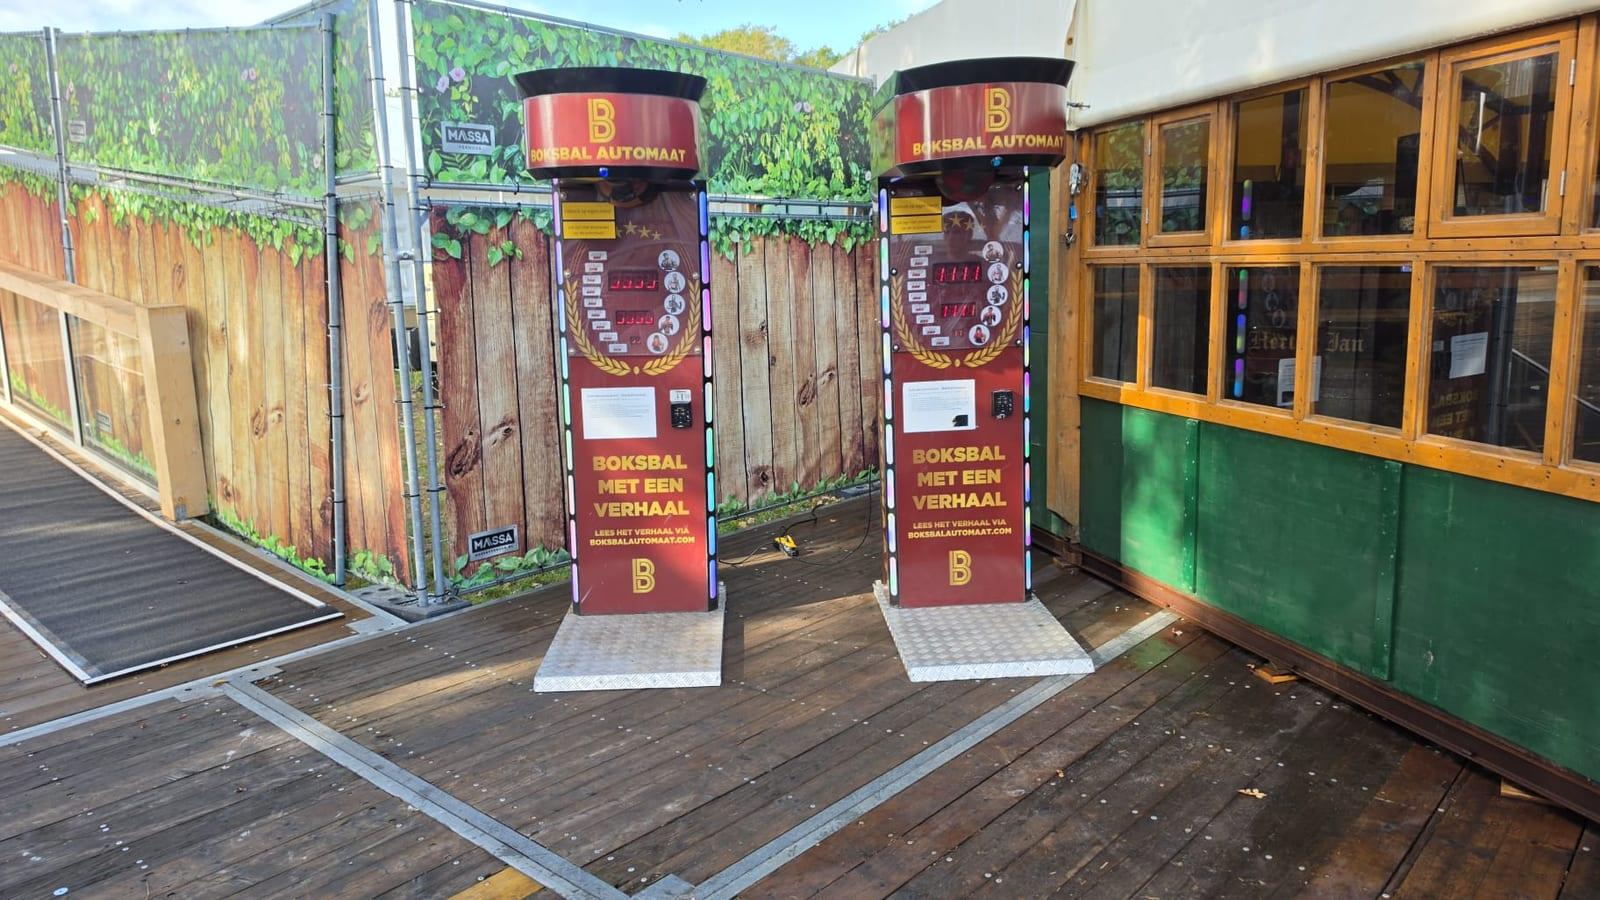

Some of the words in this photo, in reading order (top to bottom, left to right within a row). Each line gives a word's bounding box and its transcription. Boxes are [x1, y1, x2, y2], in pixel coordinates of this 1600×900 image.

[984, 88, 1011, 132] B
[588, 98, 616, 143] B
[448, 128, 490, 144] MASSA
[912, 136, 987, 156] BOKSBAL
[991, 134, 1064, 149] AUTOMAAT
[531, 146, 592, 162] BOKSBAL
[596, 146, 686, 162] AUTOMAAT
[1249, 329, 1297, 350] Hert
[592, 454, 688, 471] BOKSBAL
[912, 446, 1006, 464] BOKSBAL
[598, 478, 640, 494] MET
[644, 478, 684, 494] EEN
[917, 470, 958, 487] MET
[962, 469, 1001, 485] EEN
[593, 501, 690, 518] VERHAAL
[912, 492, 1007, 510] VERHAAL
[594, 529, 615, 537] LEES
[618, 528, 633, 536] HET
[634, 528, 674, 536] VERHAAL
[675, 527, 690, 535] VIA
[913, 522, 933, 530] LEES
[934, 520, 952, 528] HET
[952, 520, 990, 528] VERHAAL
[992, 518, 1007, 526] VIA
[474, 532, 513, 550] MASSA
[590, 536, 696, 546] BOKSBALAUTOMAAT.COM
[908, 528, 1012, 539] BOKSBALAUTOMAAT.COM
[632, 558, 656, 594] B
[949, 550, 972, 586] B
